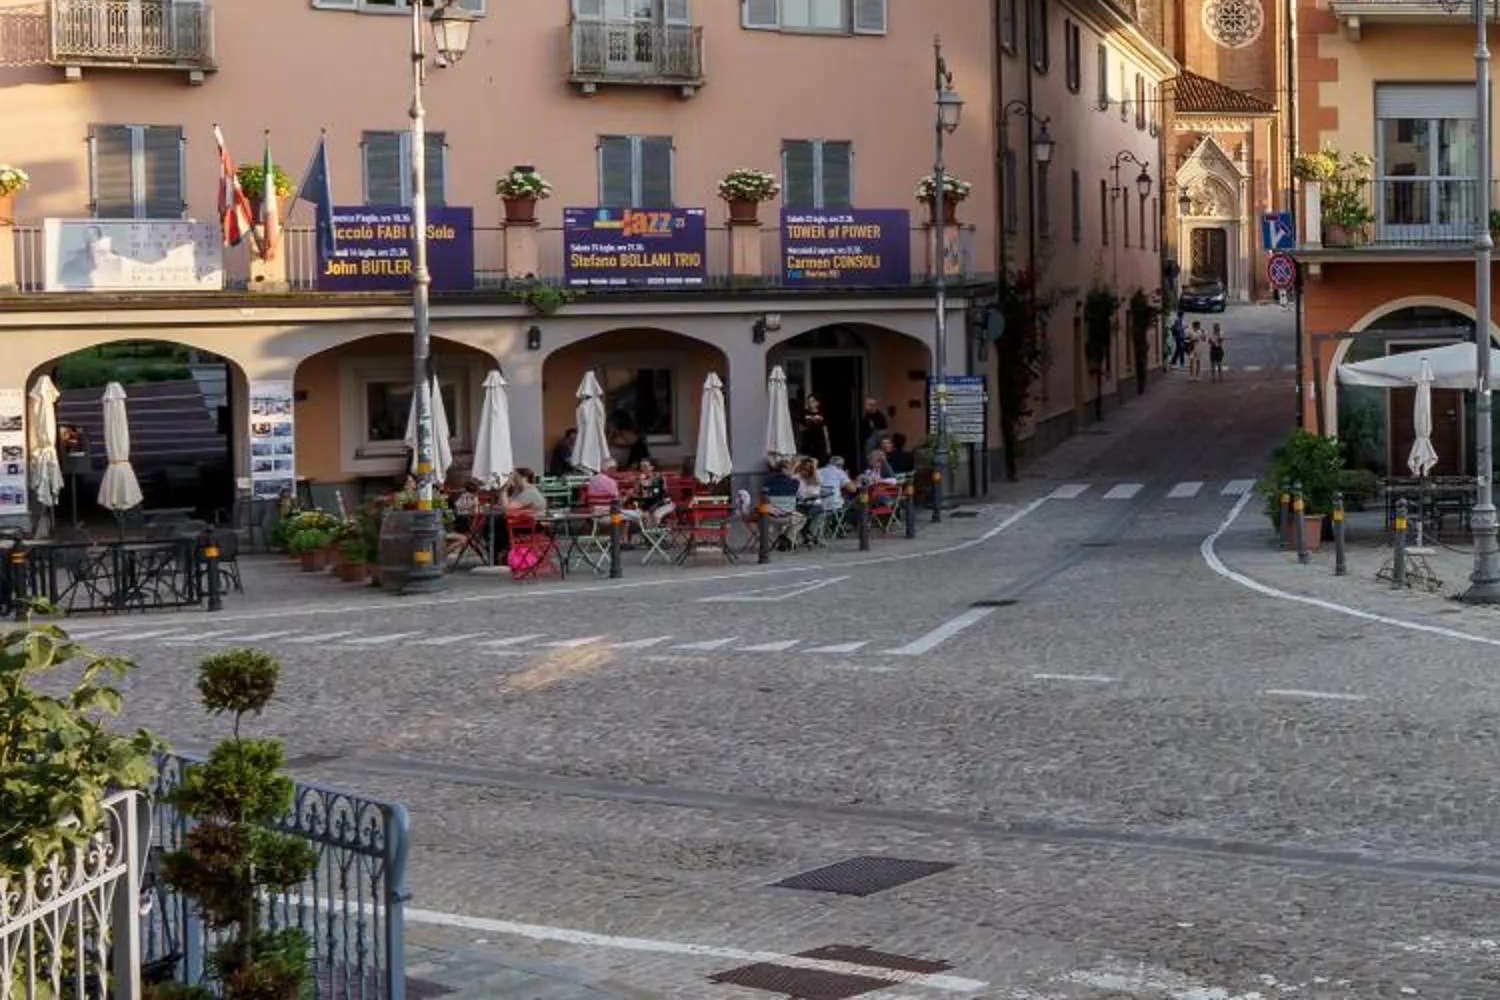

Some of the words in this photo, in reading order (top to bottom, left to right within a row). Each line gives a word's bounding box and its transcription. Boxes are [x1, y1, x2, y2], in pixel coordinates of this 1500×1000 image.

[335, 224, 373, 239] iccolò
[377, 224, 406, 239] FABI
[427, 224, 456, 239] Solo
[787, 225, 825, 239] TOWER
[842, 225, 881, 239] POWER
[325, 259, 357, 275] John
[360, 259, 412, 275] BUTLER
[570, 253, 617, 268] Stefano
[620, 253, 671, 268] BOLLANI
[674, 252, 701, 268] TRIO
[787, 255, 831, 269] Carmen
[833, 255, 881, 269] CONSOLI
